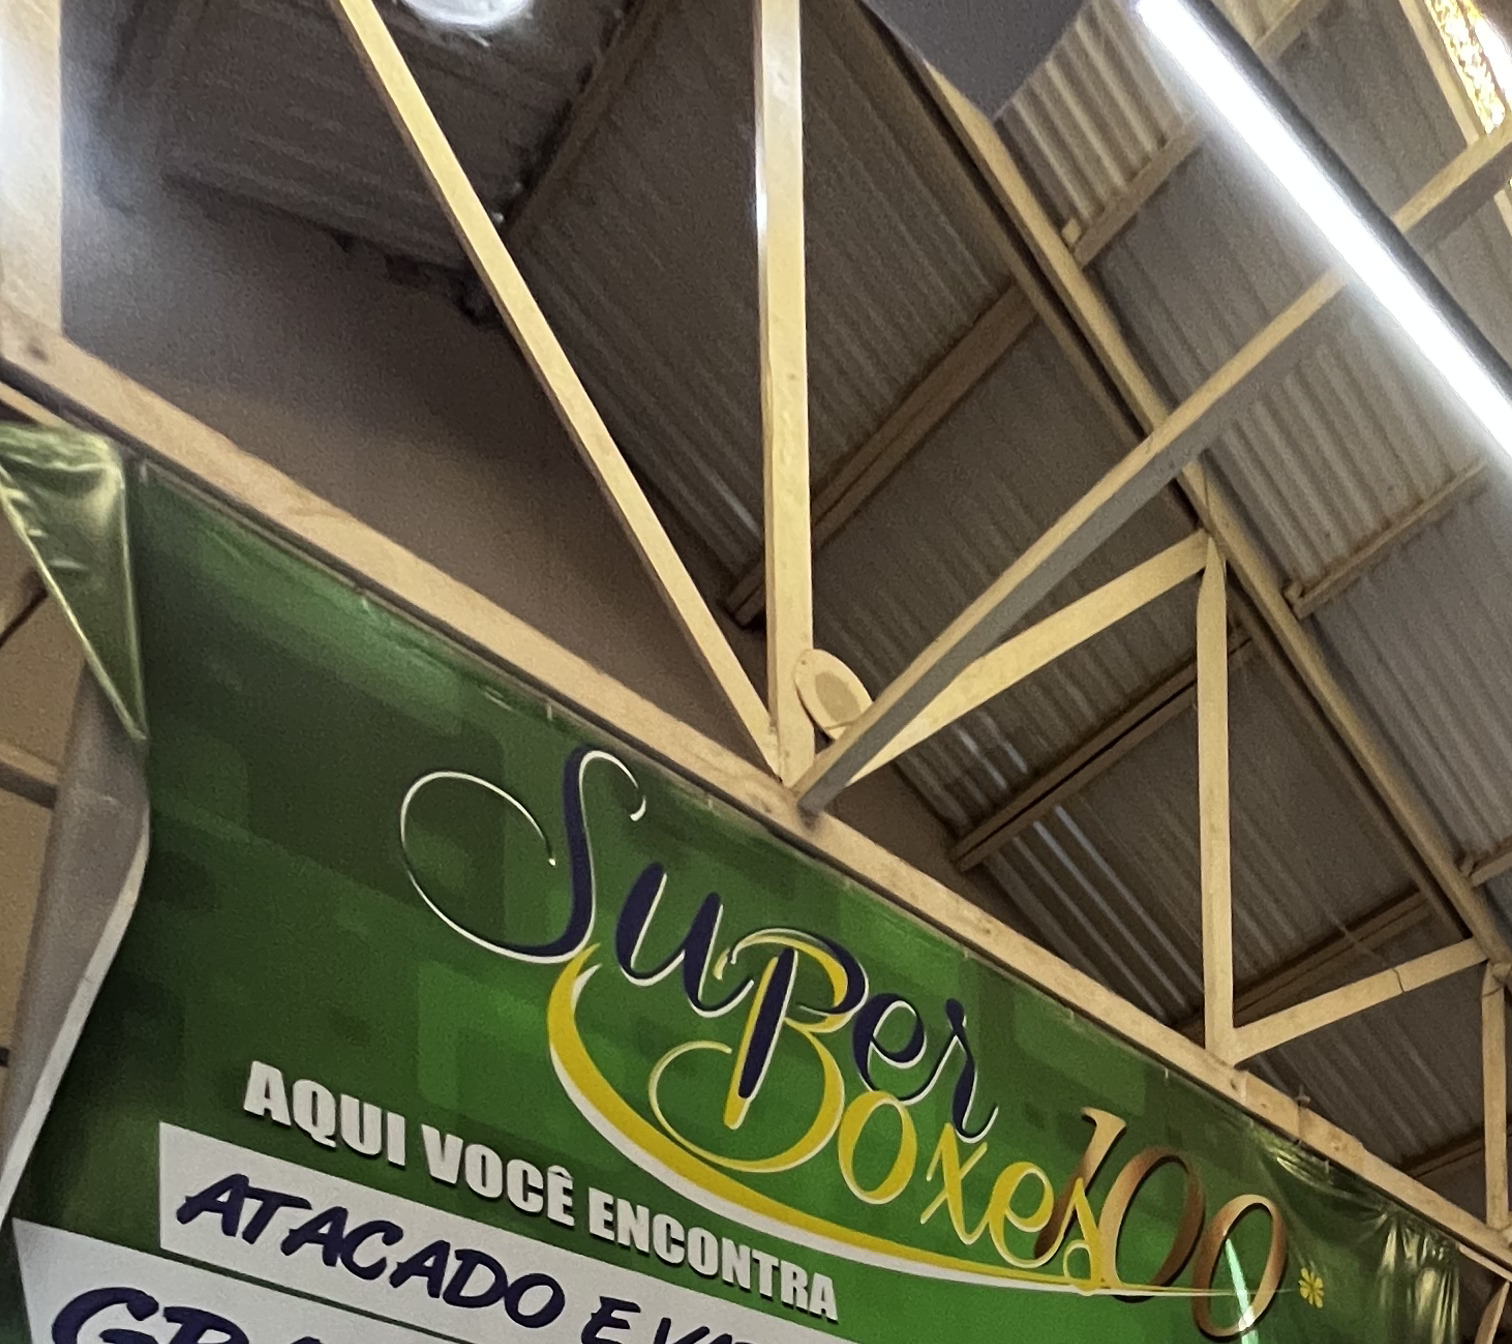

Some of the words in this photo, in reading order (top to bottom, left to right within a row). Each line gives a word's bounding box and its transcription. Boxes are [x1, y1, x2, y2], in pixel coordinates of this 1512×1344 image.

[176, 1172, 565, 1329] ATACADO
[242, 1060, 408, 1162] AQUI
[421, 1124, 577, 1225] VOCÊ
[588, 1193, 839, 1322] ENCONTRA
[648, 930, 1104, 1291] Boxes
[1034, 1107, 1288, 1340] 100
